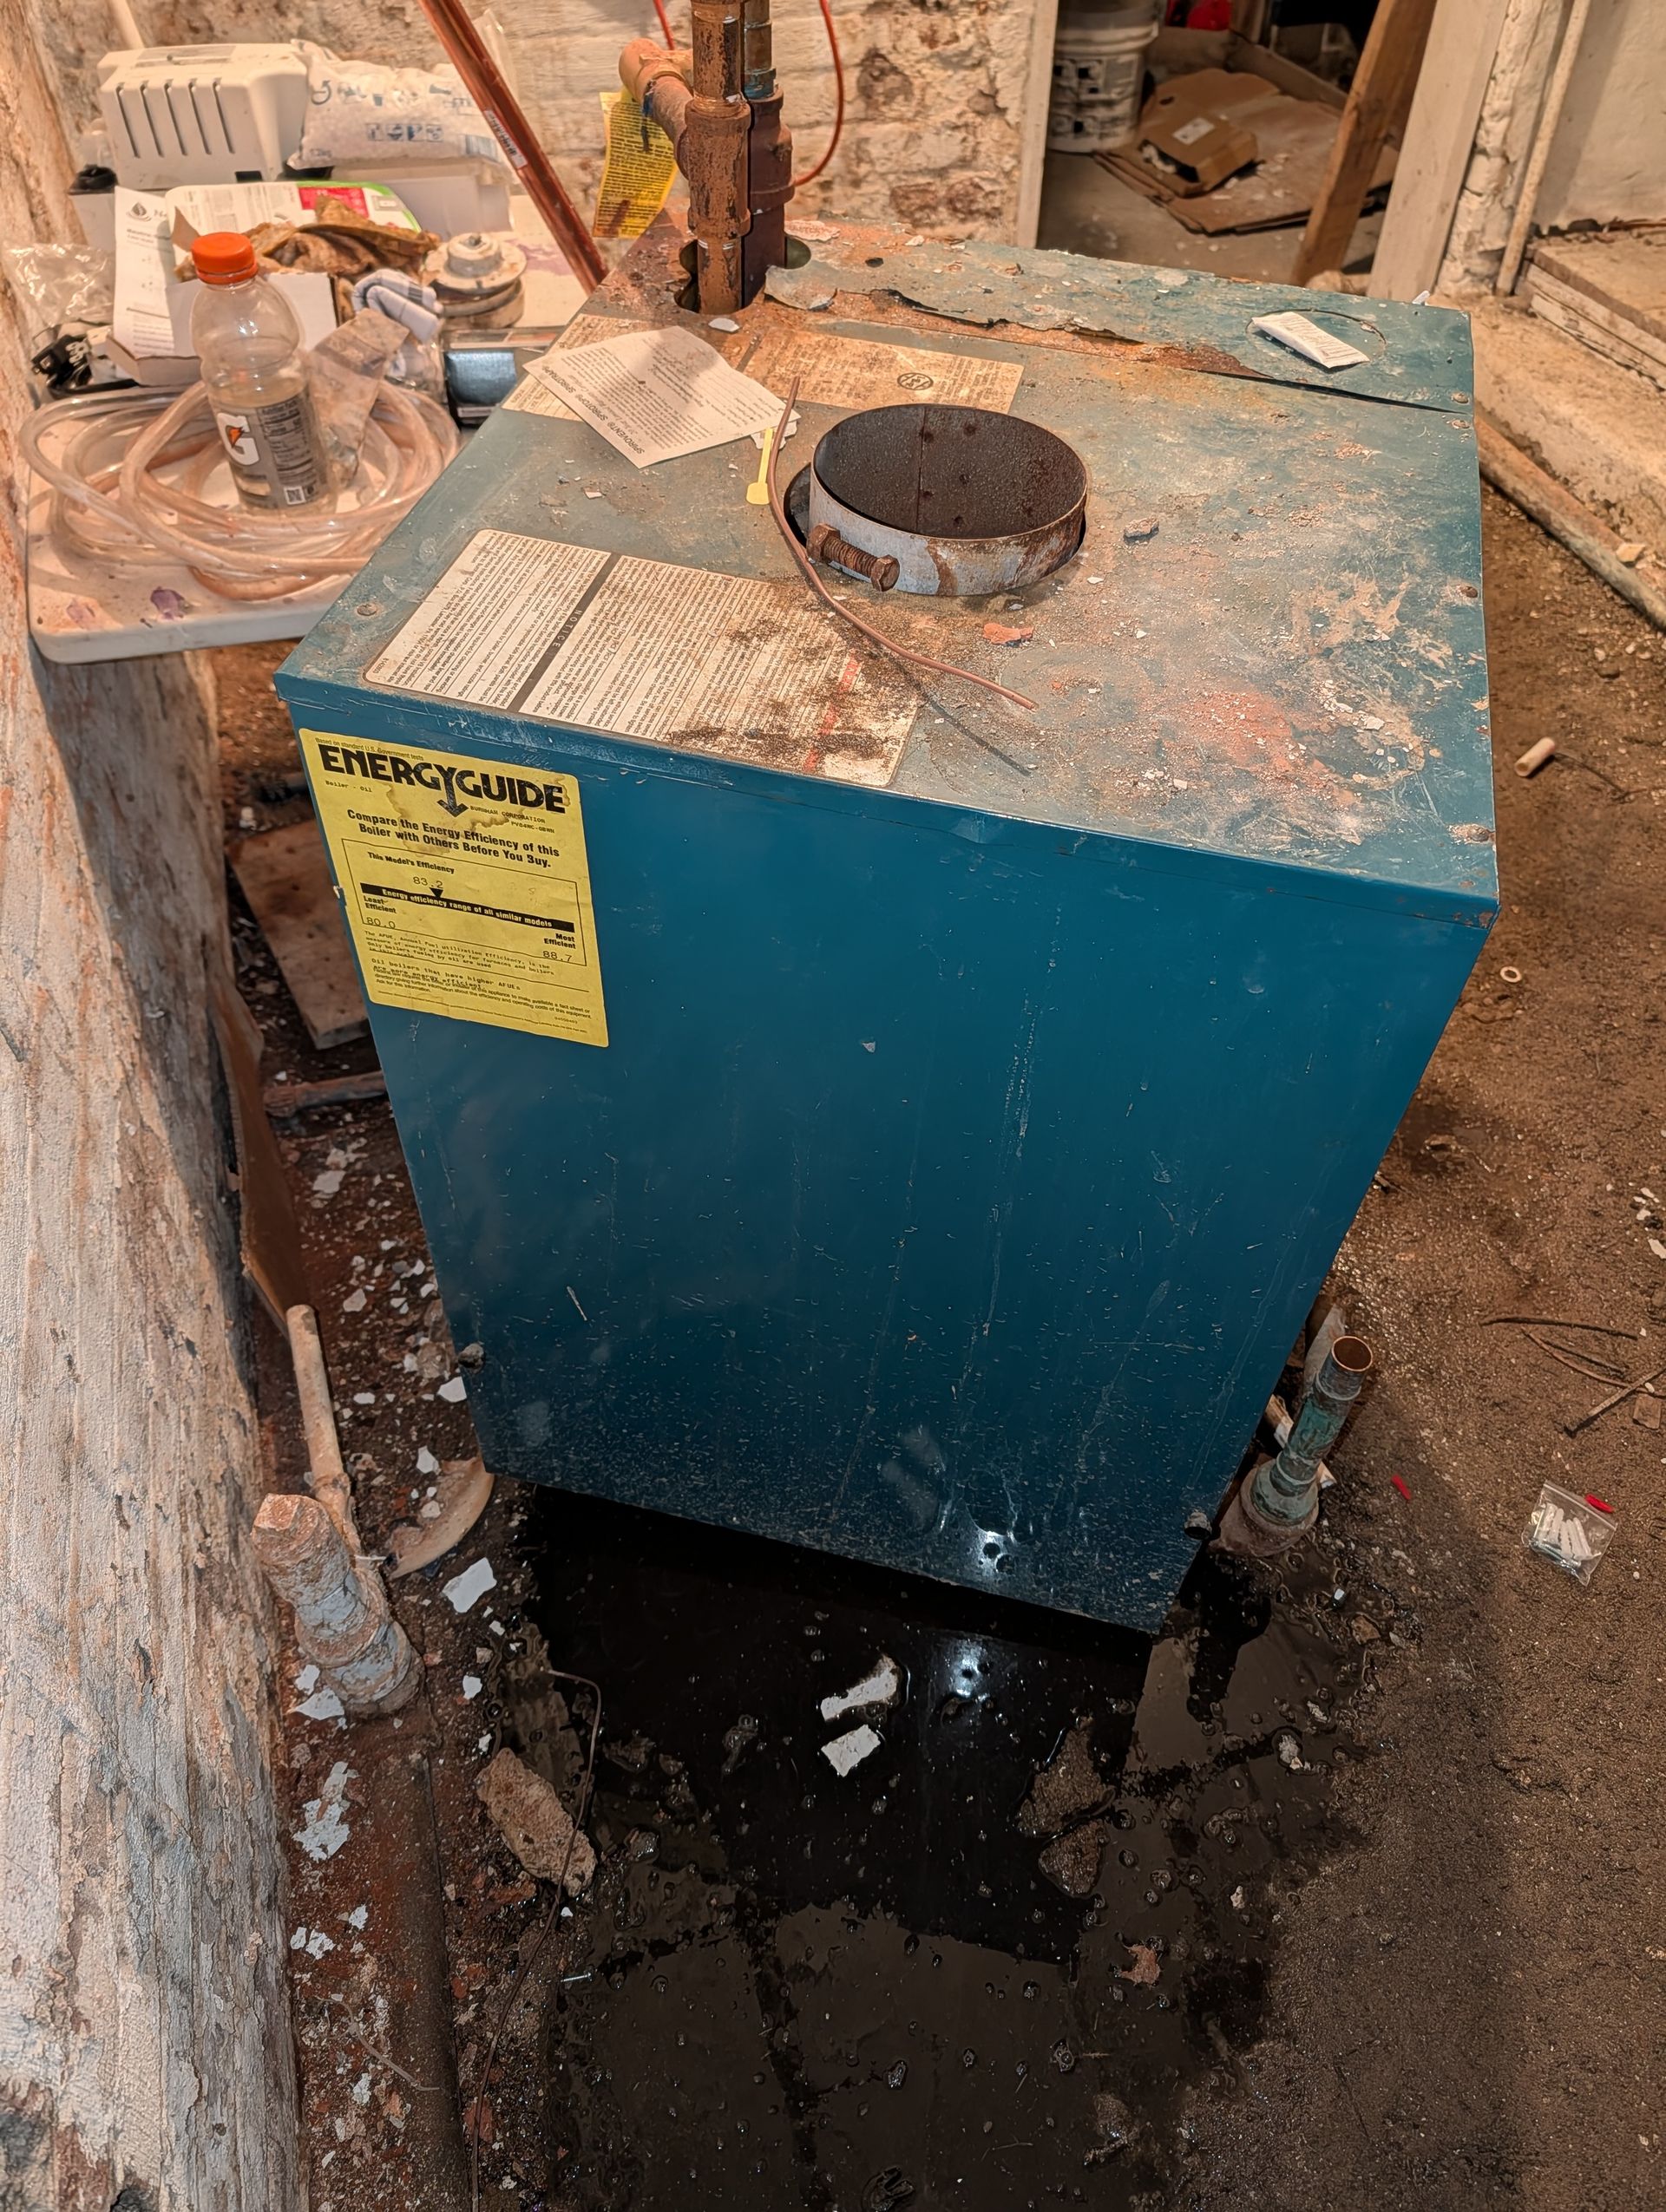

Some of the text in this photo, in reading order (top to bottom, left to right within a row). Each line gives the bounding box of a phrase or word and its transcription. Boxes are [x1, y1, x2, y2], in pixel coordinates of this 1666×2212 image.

[217, 412, 259, 466] G
[551, 609, 582, 647] NOTICE
[318, 743, 565, 813] ENERGYGUIDE
[501, 811, 545, 823] CORPORATION
[346, 808, 560, 856] Compare the Energy Efficiency of this
[358, 822, 551, 869] Boiler with Others Before You Buy.
[367, 851, 455, 874] This Model's Efficiency
[412, 875, 443, 888] 83.2
[363, 895, 384, 904] Least
[364, 902, 397, 913] Efficient
[381, 888, 408, 900] Energy
[409, 893, 447, 908] efficiency
[449, 903, 471, 913] range
[495, 910, 521, 921] similar
[523, 915, 552, 927] models
[365, 916, 396, 929] 80.0
[543, 938, 575, 948] Efficient
[555, 933, 574, 942] Most
[542, 950, 573, 962] 88.7
[389, 961, 419, 971] boilers
[467, 976, 494, 985] higher
